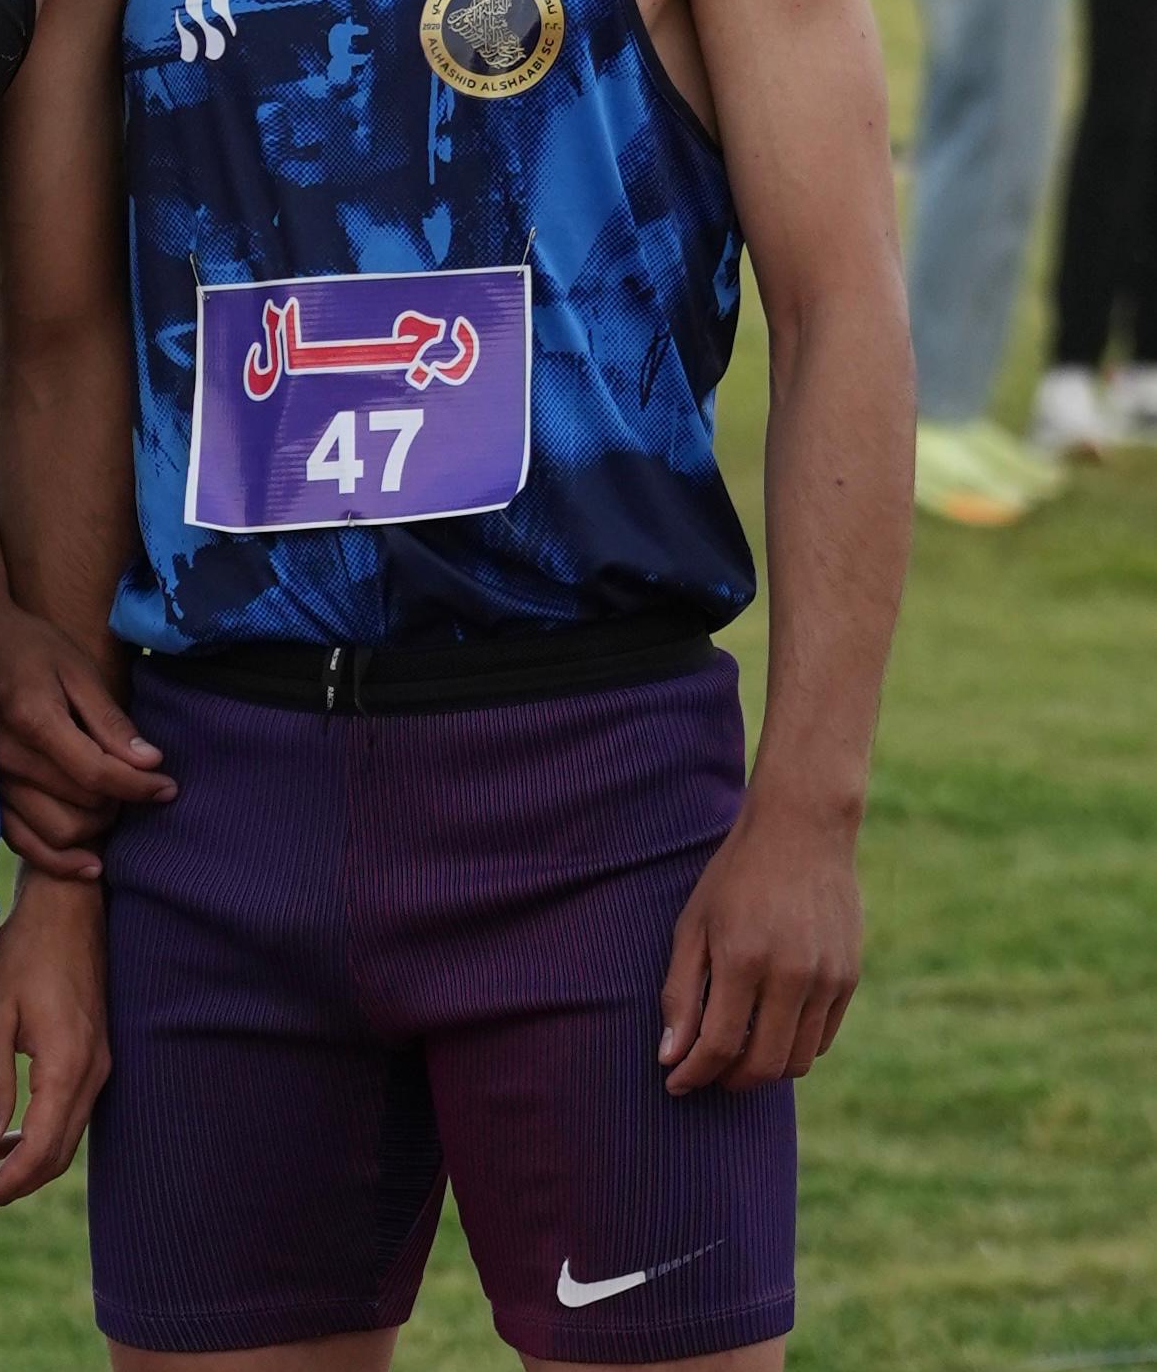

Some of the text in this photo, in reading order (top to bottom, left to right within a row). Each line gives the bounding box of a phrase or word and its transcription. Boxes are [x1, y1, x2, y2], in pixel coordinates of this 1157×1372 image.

[427, 37, 555, 92] ALHASHID ALSHAABI SC
[243, 296, 479, 401] رجال
[306, 409, 424, 495] 47
